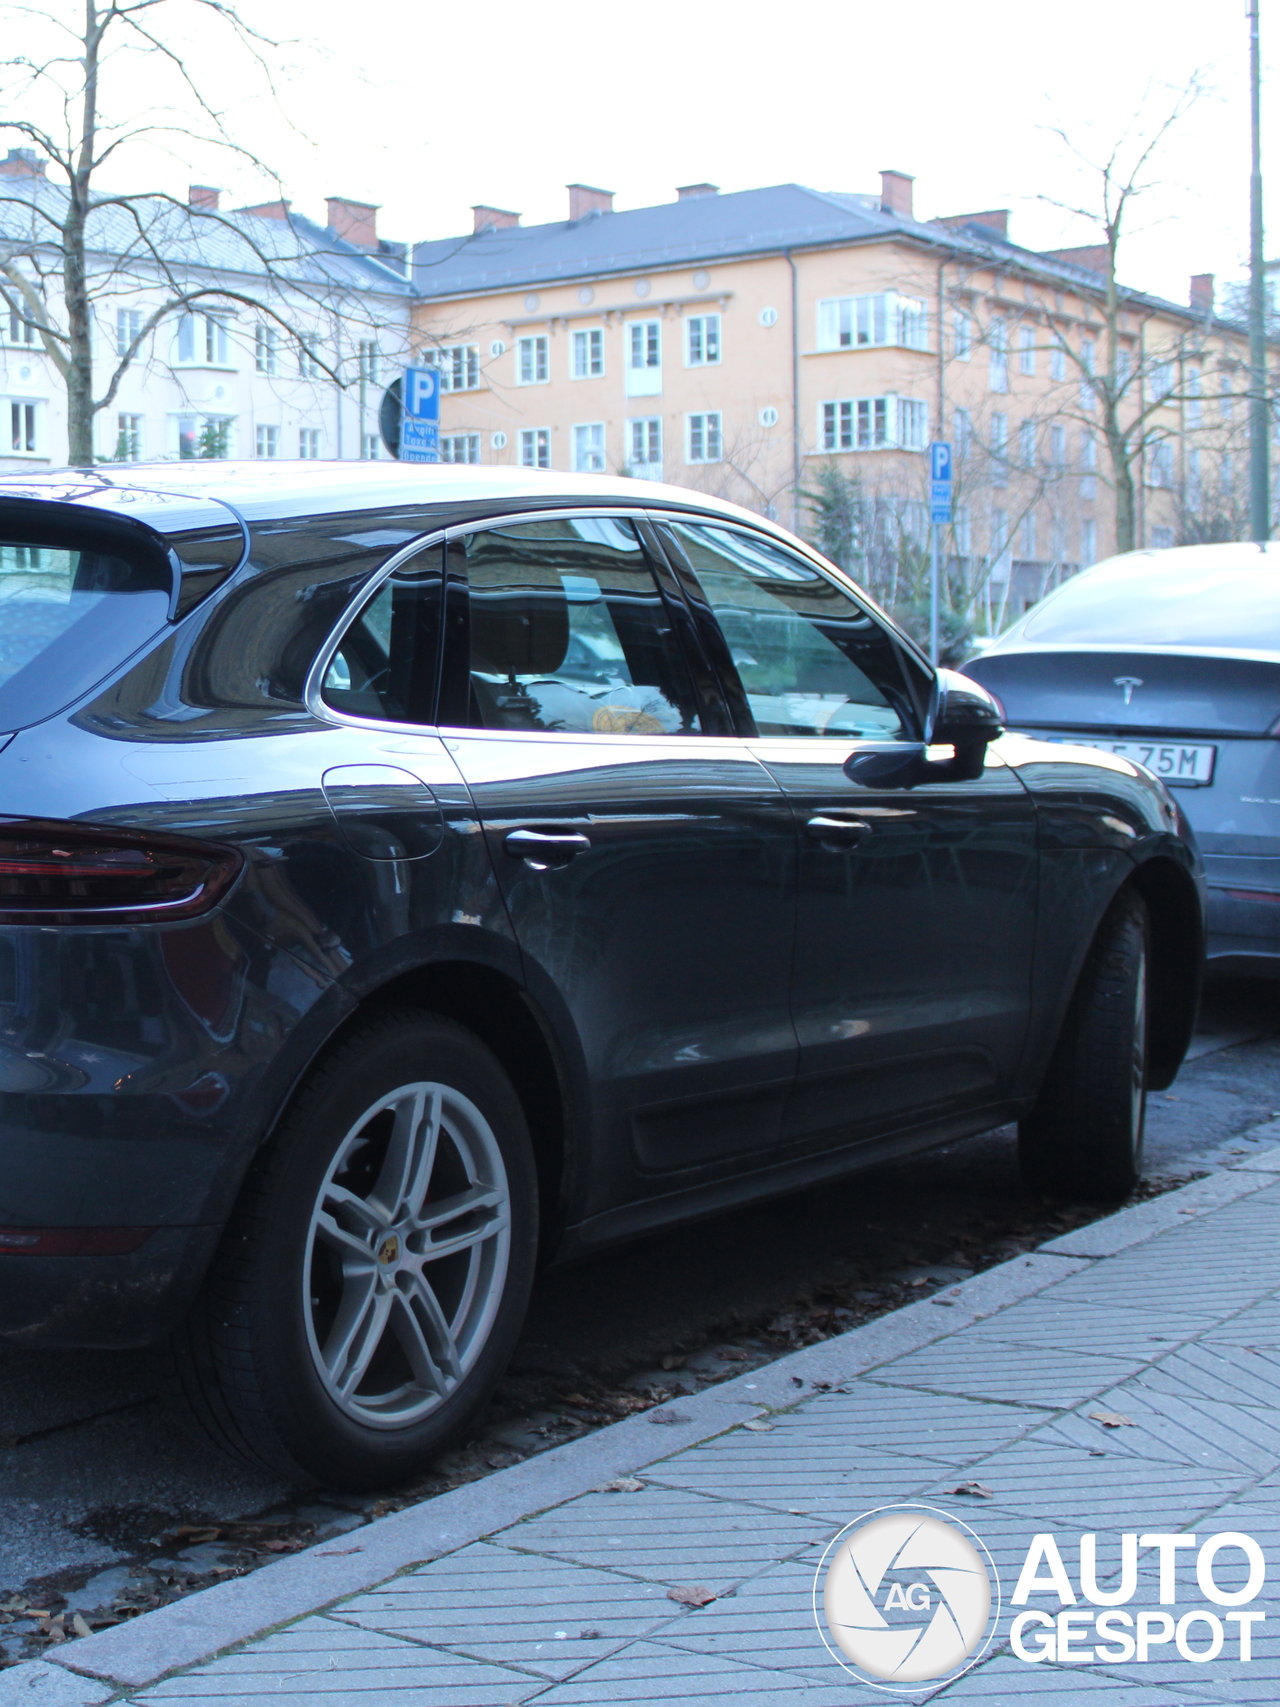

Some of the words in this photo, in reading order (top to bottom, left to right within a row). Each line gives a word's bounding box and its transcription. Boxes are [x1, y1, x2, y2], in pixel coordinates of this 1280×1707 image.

[413, 371, 435, 415] P
[936, 446, 949, 478] P
[1139, 748, 1199, 776] 75M
